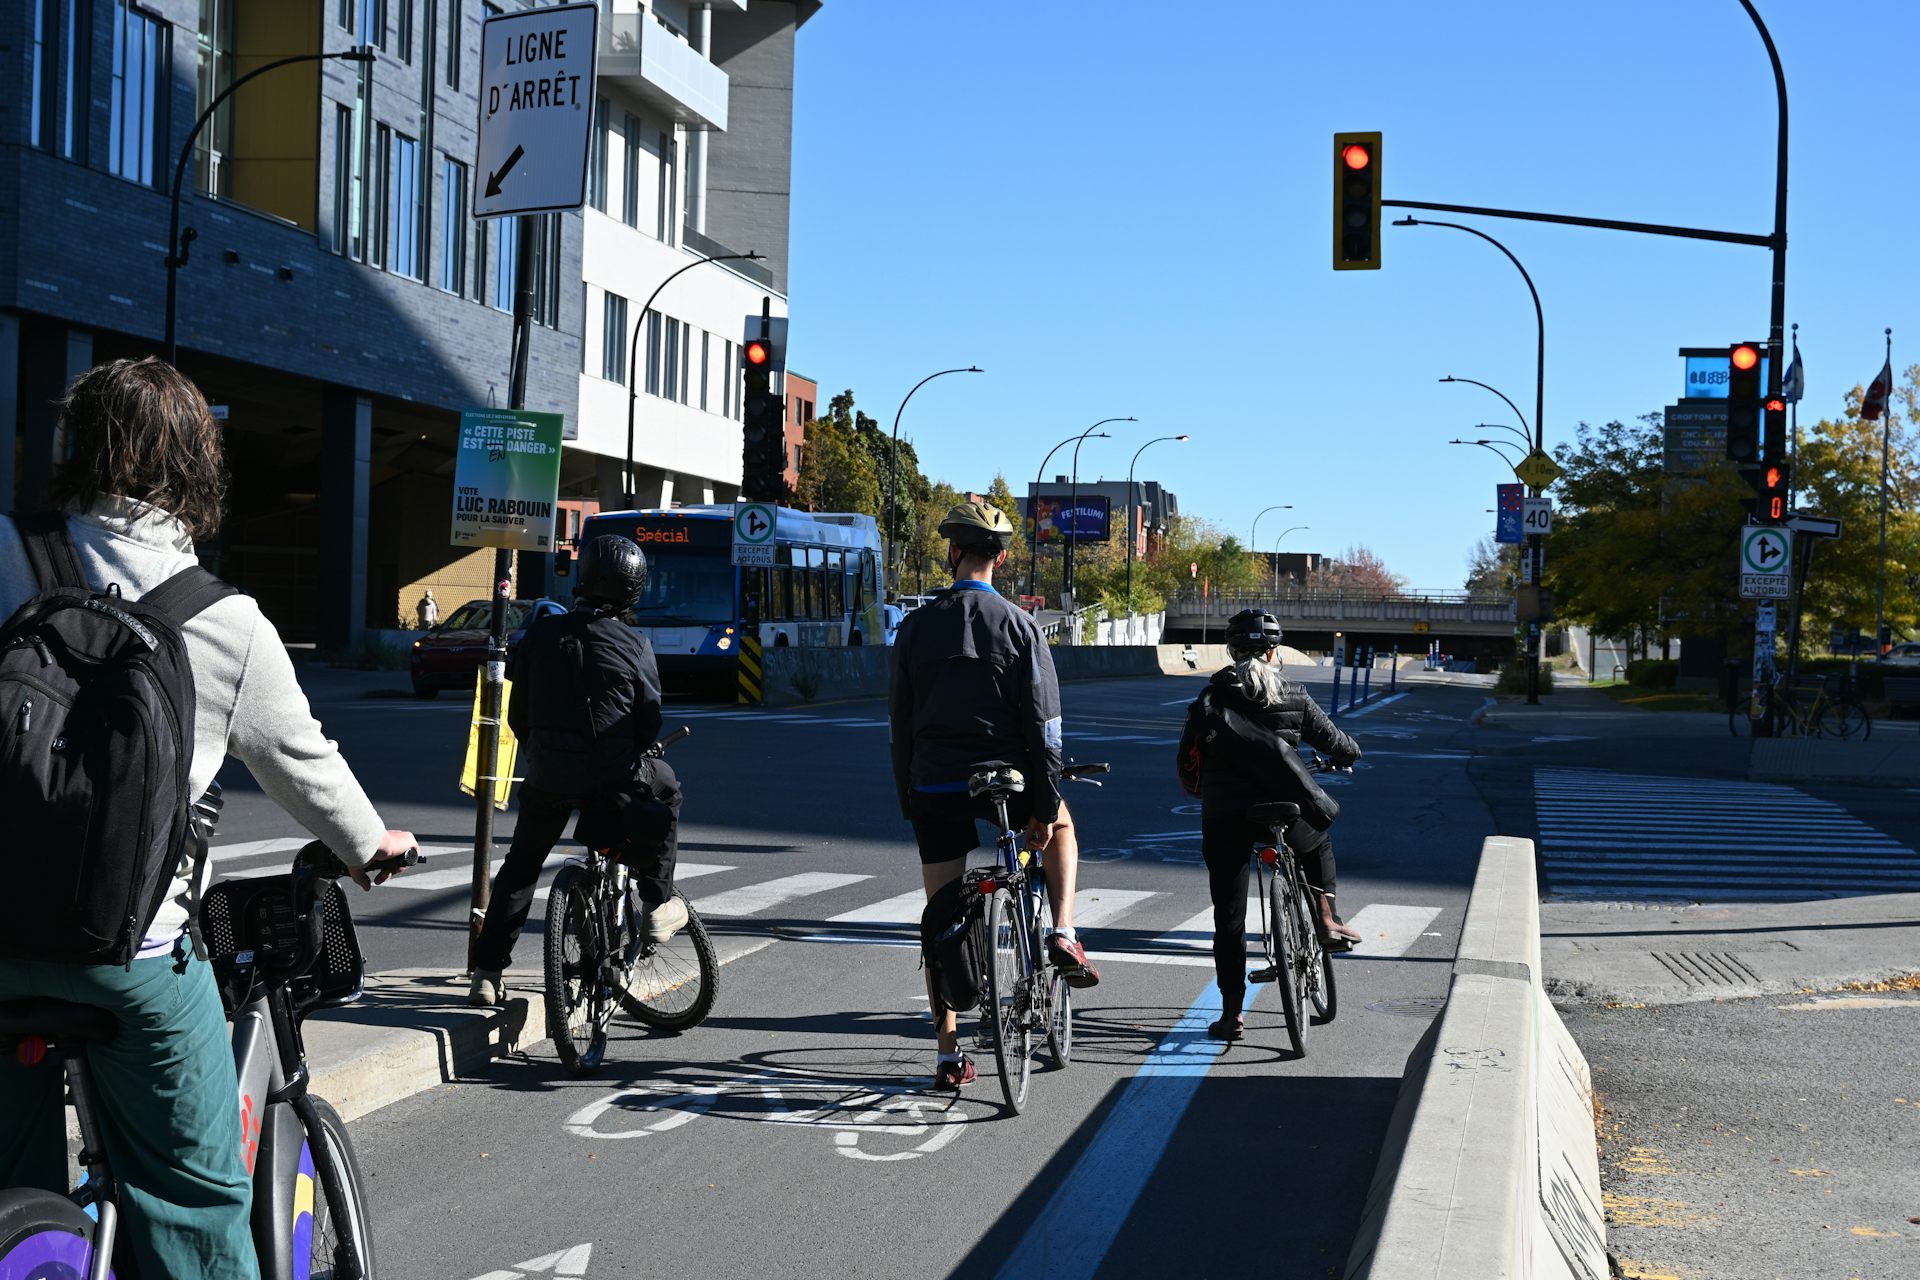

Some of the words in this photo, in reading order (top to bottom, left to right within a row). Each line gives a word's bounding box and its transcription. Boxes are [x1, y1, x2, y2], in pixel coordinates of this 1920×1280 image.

[506, 29, 567, 66] LIGNE
[475, 426, 504, 438] CETTE
[506, 429, 535, 440] PISTE
[463, 438, 484, 449] EST
[507, 441, 546, 454] DANGER
[488, 449, 506, 462] EN
[459, 487, 479, 495] VOTE
[457, 496, 484, 512] LUC
[488, 499, 551, 517] RABOUIN
[456, 513, 478, 522] POUR
[480, 514, 490, 523] LA
[492, 515, 525, 526] SAUVER
[1525, 510, 1550, 529] 40
[636, 526, 689, 544] Spécial
[736, 555, 772, 564] AUTOBUS
[1743, 585, 1788, 595] AUTOBUS
